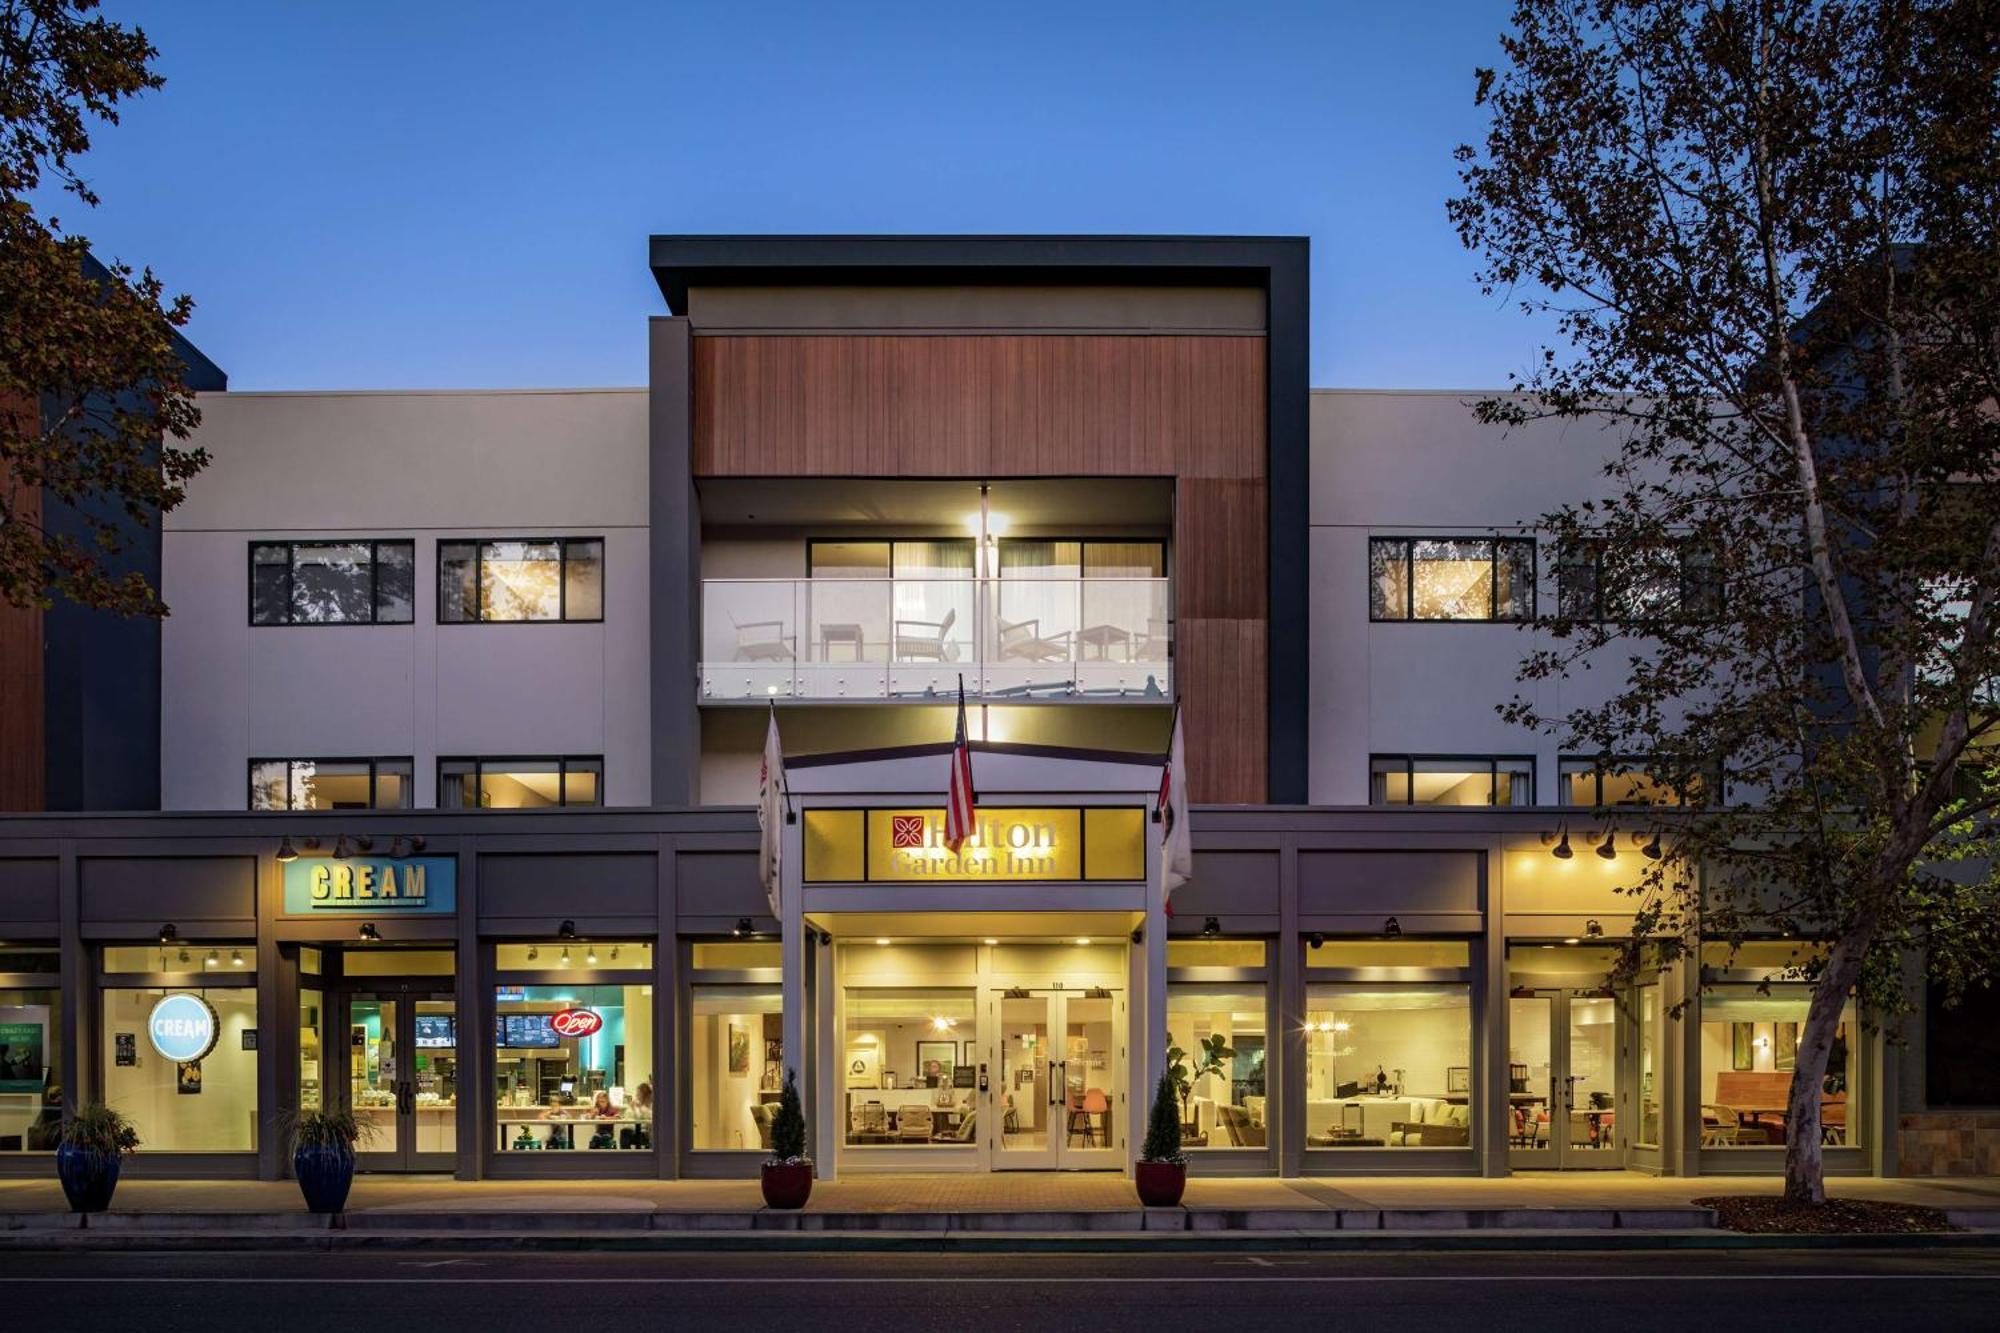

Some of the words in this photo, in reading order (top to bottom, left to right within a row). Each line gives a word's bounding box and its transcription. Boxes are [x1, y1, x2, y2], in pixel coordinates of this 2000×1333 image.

[891, 851, 999, 875] Garden
[1008, 852, 1056, 874] Inn
[311, 864, 428, 900] CREAM
[155, 1019, 208, 1038] CREAM
[554, 1012, 598, 1033] Open
